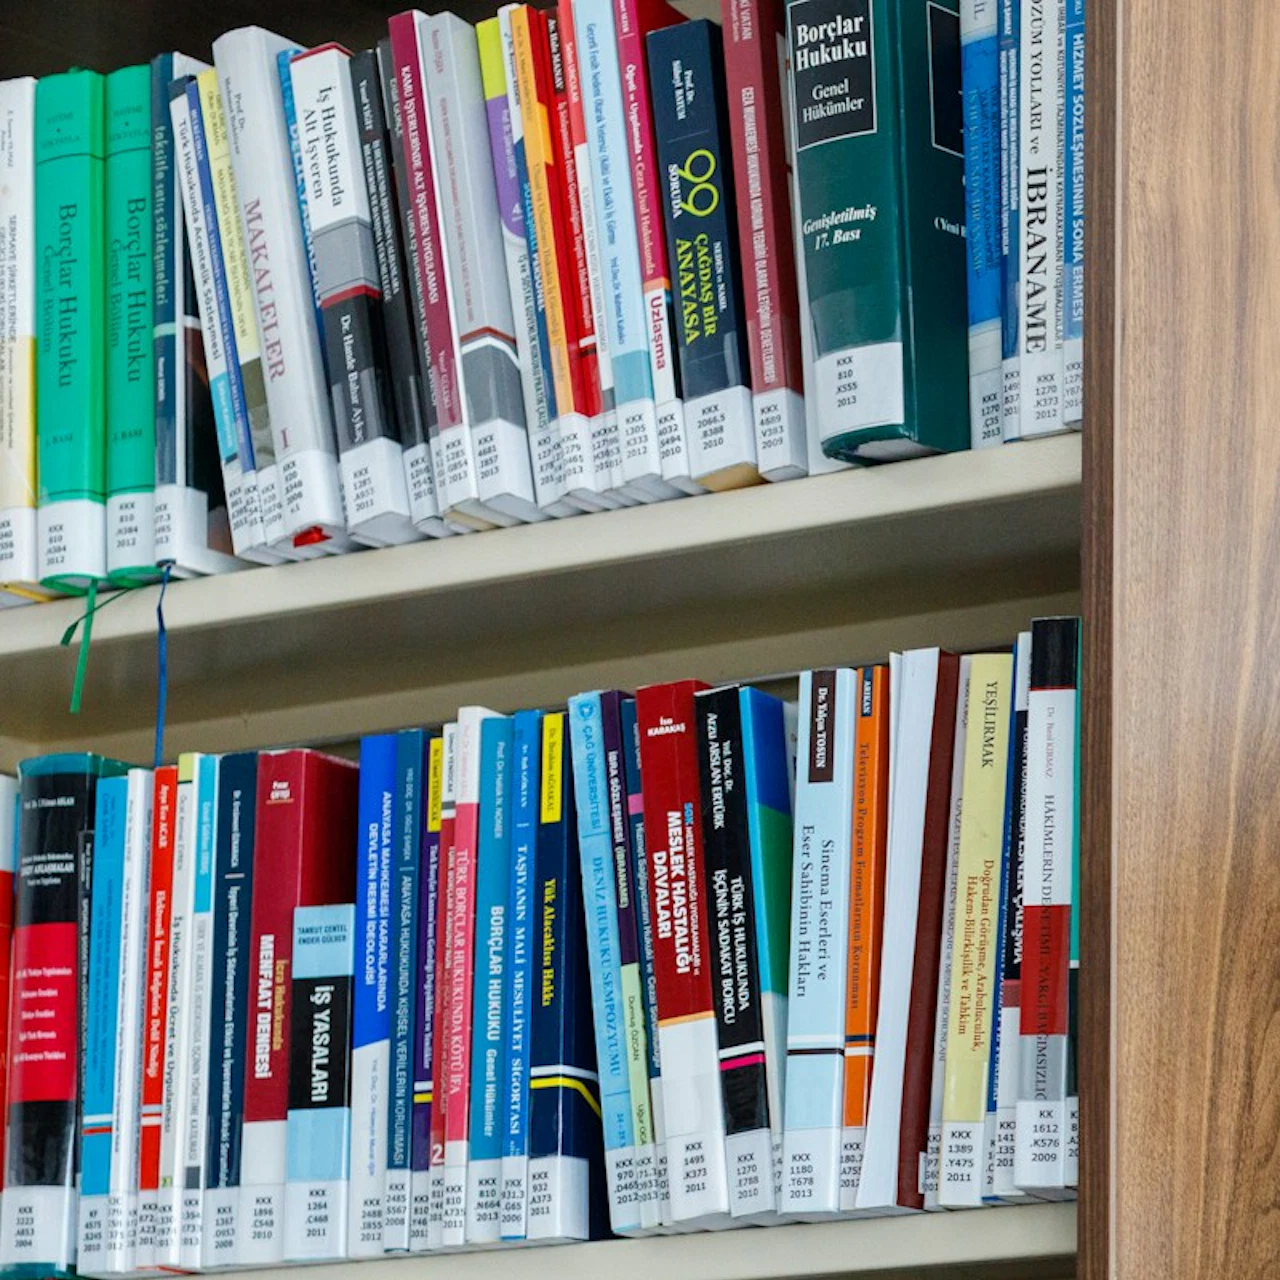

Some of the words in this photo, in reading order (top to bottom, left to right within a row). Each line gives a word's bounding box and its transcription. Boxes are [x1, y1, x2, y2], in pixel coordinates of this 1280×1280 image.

[796, 15, 864, 46] Borçlar
[796, 39, 867, 71] Hukuku
[802, 97, 864, 123] Hükümler
[812, 79, 849, 101] Genel
[668, 163, 682, 219] SORUDA
[124, 197, 146, 282] Borçlar
[803, 204, 877, 235] Genişletilmiş
[815, 233, 830, 250] 17.
[833, 228, 861, 245] Bası
[54, 204, 77, 289] Borçlar
[694, 233, 714, 303] ÇAĞDAŞ
[1026, 165, 1053, 353] İBRANAME
[676, 238, 700, 346] ANAYASA
[58, 297, 77, 387] Hukuku
[127, 291, 146, 382] Hukuku
[651, 296, 666, 370] Uzlaşma
[703, 306, 719, 338] BİR
[707, 713, 718, 739] Arzu
[981, 680, 998, 769] YEŞİLIRMAK
[709, 741, 722, 785] ARSLAN
[712, 787, 726, 830] ERTÜRK
[667, 811, 684, 878] MESLEK
[801, 825, 815, 858] Eser
[515, 845, 528, 921] TAŞIYANIN
[819, 839, 835, 898] Sinema
[653, 851, 671, 939] DAVALARI
[799, 862, 813, 936] Sahibinin
[514, 927, 526, 964] MALİ
[671, 880, 692, 974] HASTALIĞI
[818, 900, 832, 962] Eserleri
[258, 934, 275, 1008] MENFAAT
[797, 939, 811, 998] Hakları
[817, 968, 826, 981] ve
[310, 985, 334, 1005] İŞ
[511, 968, 525, 1051] MESULİYET
[255, 1012, 272, 1079] DENGESİ
[311, 1009, 331, 1101] YASALARI
[509, 1058, 524, 1134] SİGORTASI
[949, 1144, 973, 1154] 1389
[951, 1130, 972, 1140] KKX
[1033, 1123, 1059, 1133] 1612
[432, 1144, 444, 1164] 2
[790, 1164, 813, 1175] 1180
[791, 1153, 810, 1163] KKX
[947, 1172, 972, 1183] 2011
[1031, 1152, 1057, 1162] 2009
[790, 1188, 812, 1199] 2013
